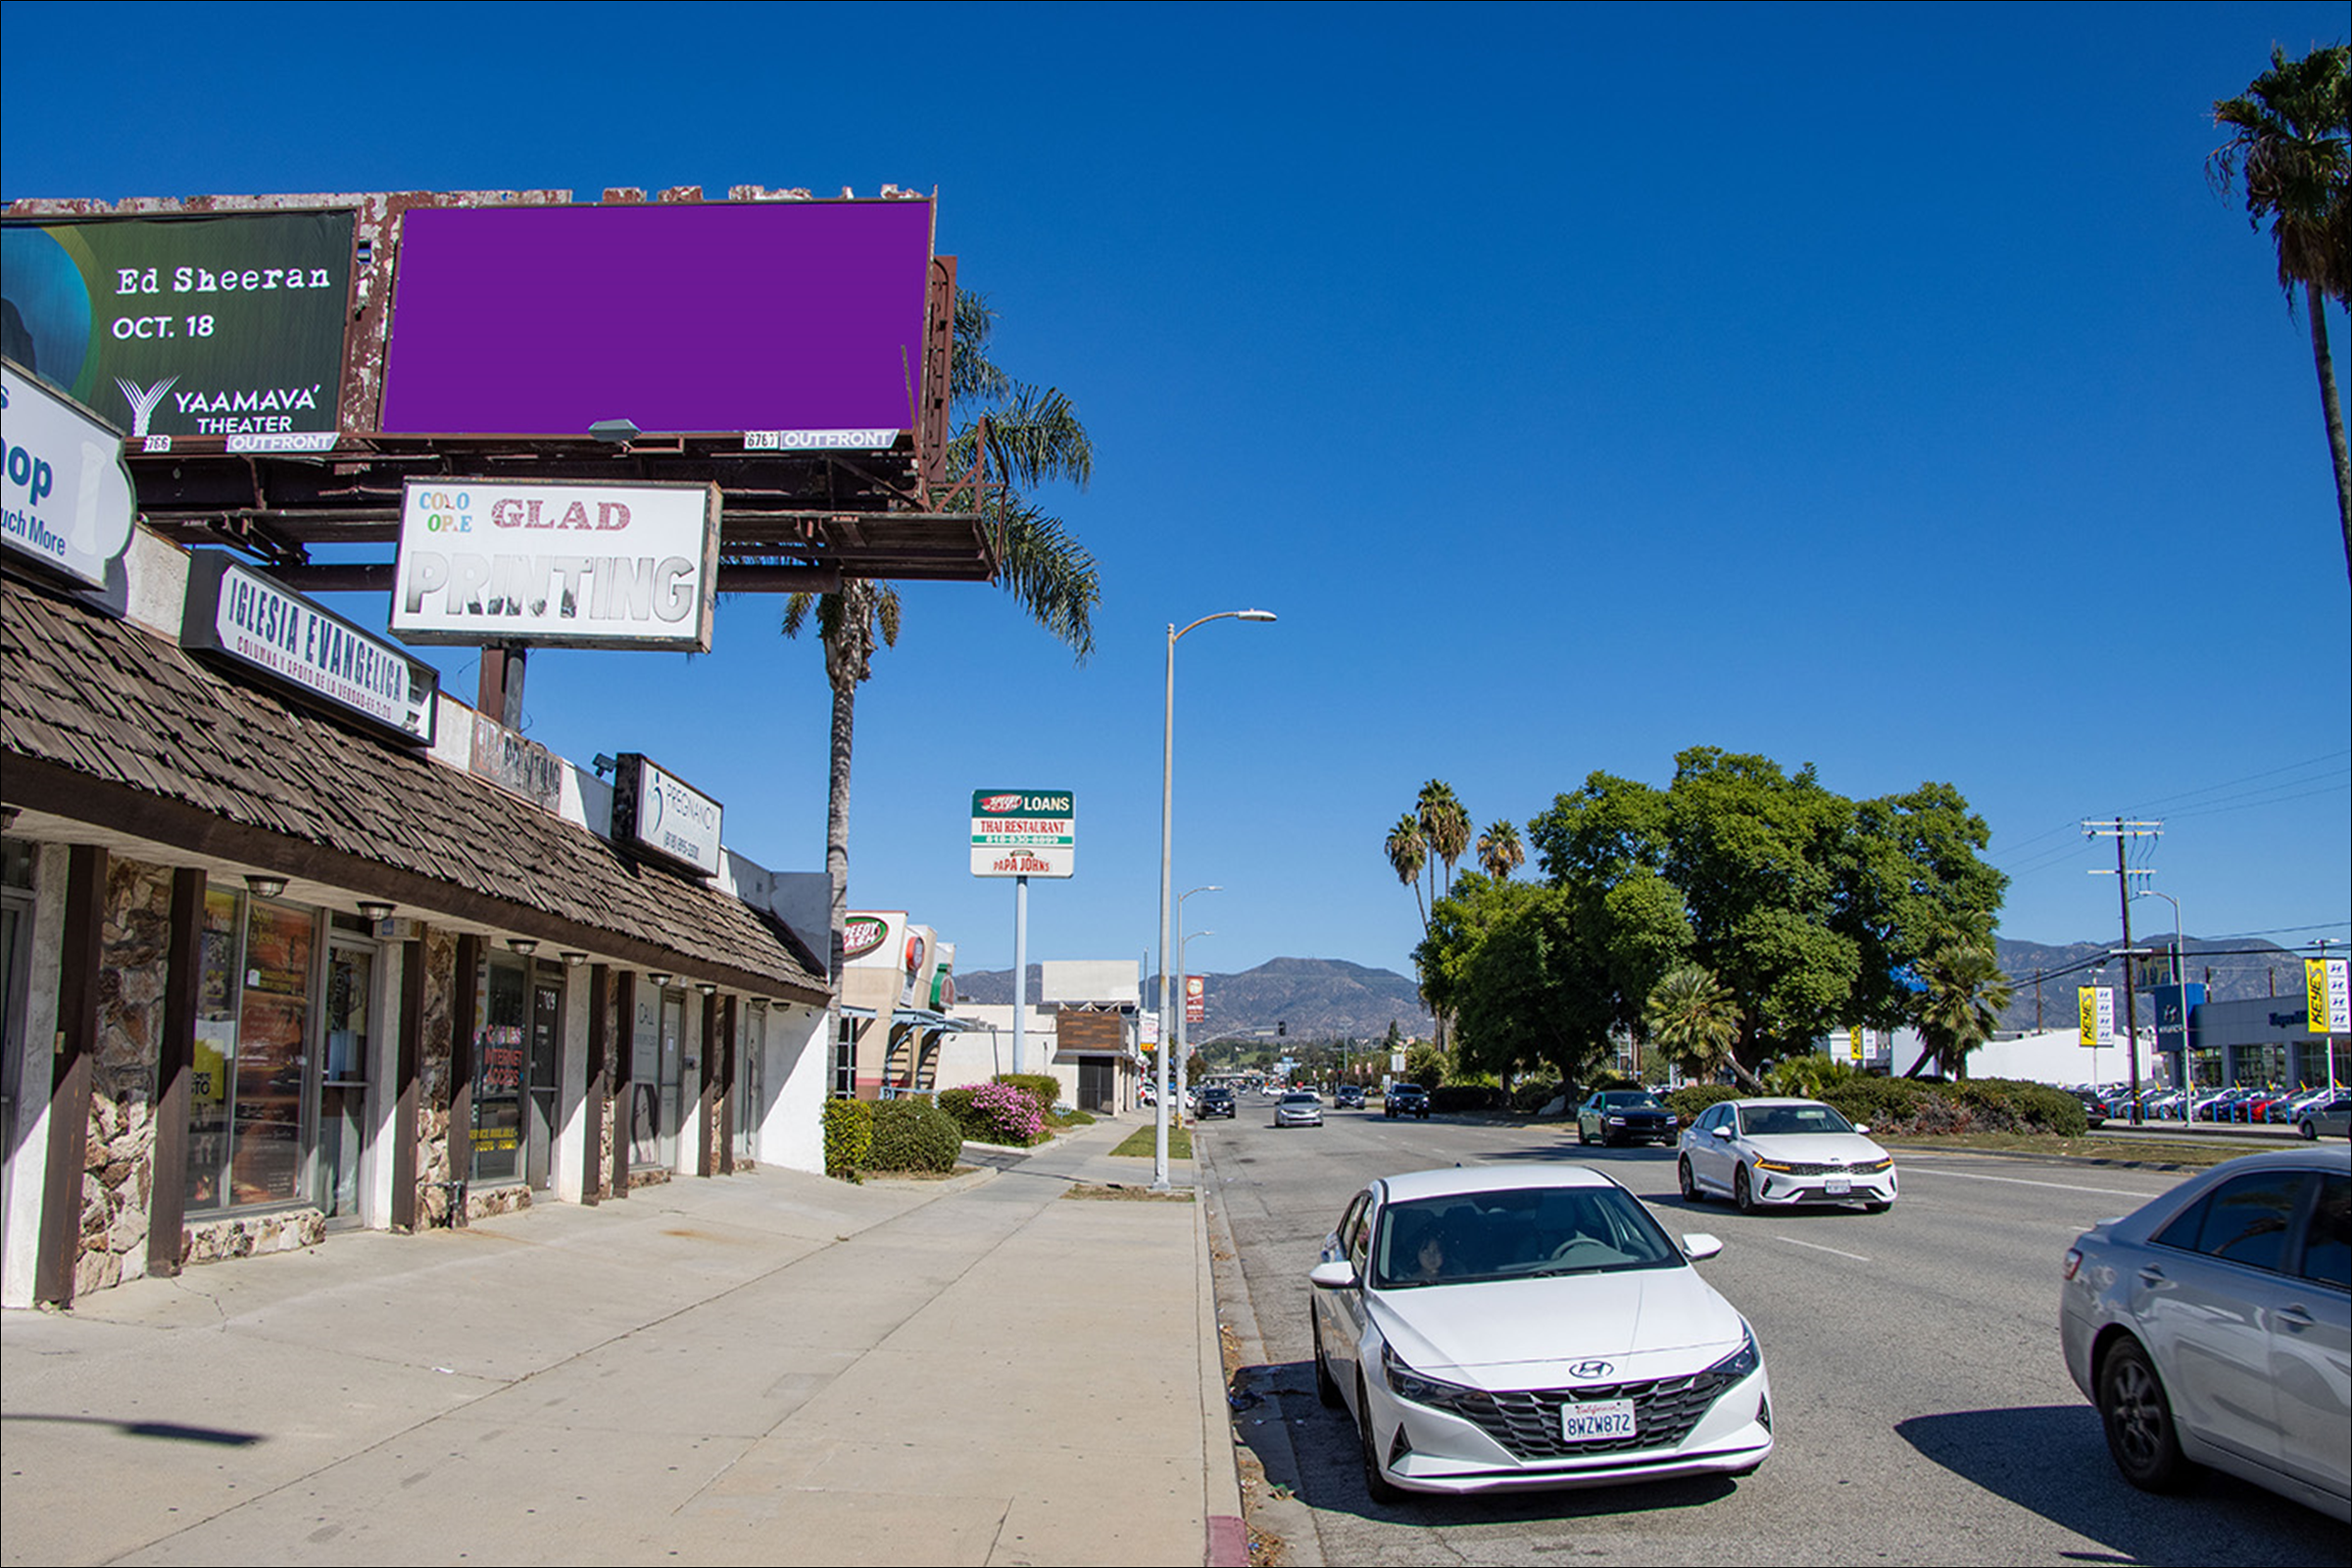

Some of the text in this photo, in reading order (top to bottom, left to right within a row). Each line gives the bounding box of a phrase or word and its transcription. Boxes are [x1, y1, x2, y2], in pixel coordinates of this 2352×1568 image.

[116, 266, 331, 295] Ed Sheeran
[112, 315, 215, 339] OCT. 18
[196, 416, 292, 434] THEATER
[230, 434, 333, 451] OUTFRONT
[784, 431, 892, 448] OUTFRONT
[1, 435, 53, 507] op
[427, 513, 472, 533] OPE
[492, 499, 632, 531] GLAD
[28, 514, 66, 556] More
[405, 551, 695, 623] PRINTING
[228, 577, 403, 703] IGLESIA EVANGELICA
[237, 635, 277, 668] COLUMNA
[288, 660, 314, 684] APOYO
[316, 672, 325, 689] DE
[326, 678, 336, 694] LA
[1023, 797, 1070, 811] LOANS
[980, 820, 1066, 834] THAI RESTAURANT
[993, 858, 1017, 872] PAPA
[844, 934, 875, 948] ASH
[2308, 964, 2327, 1027] KEYES
[1567, 1413, 1631, 1436] 8WZW872
